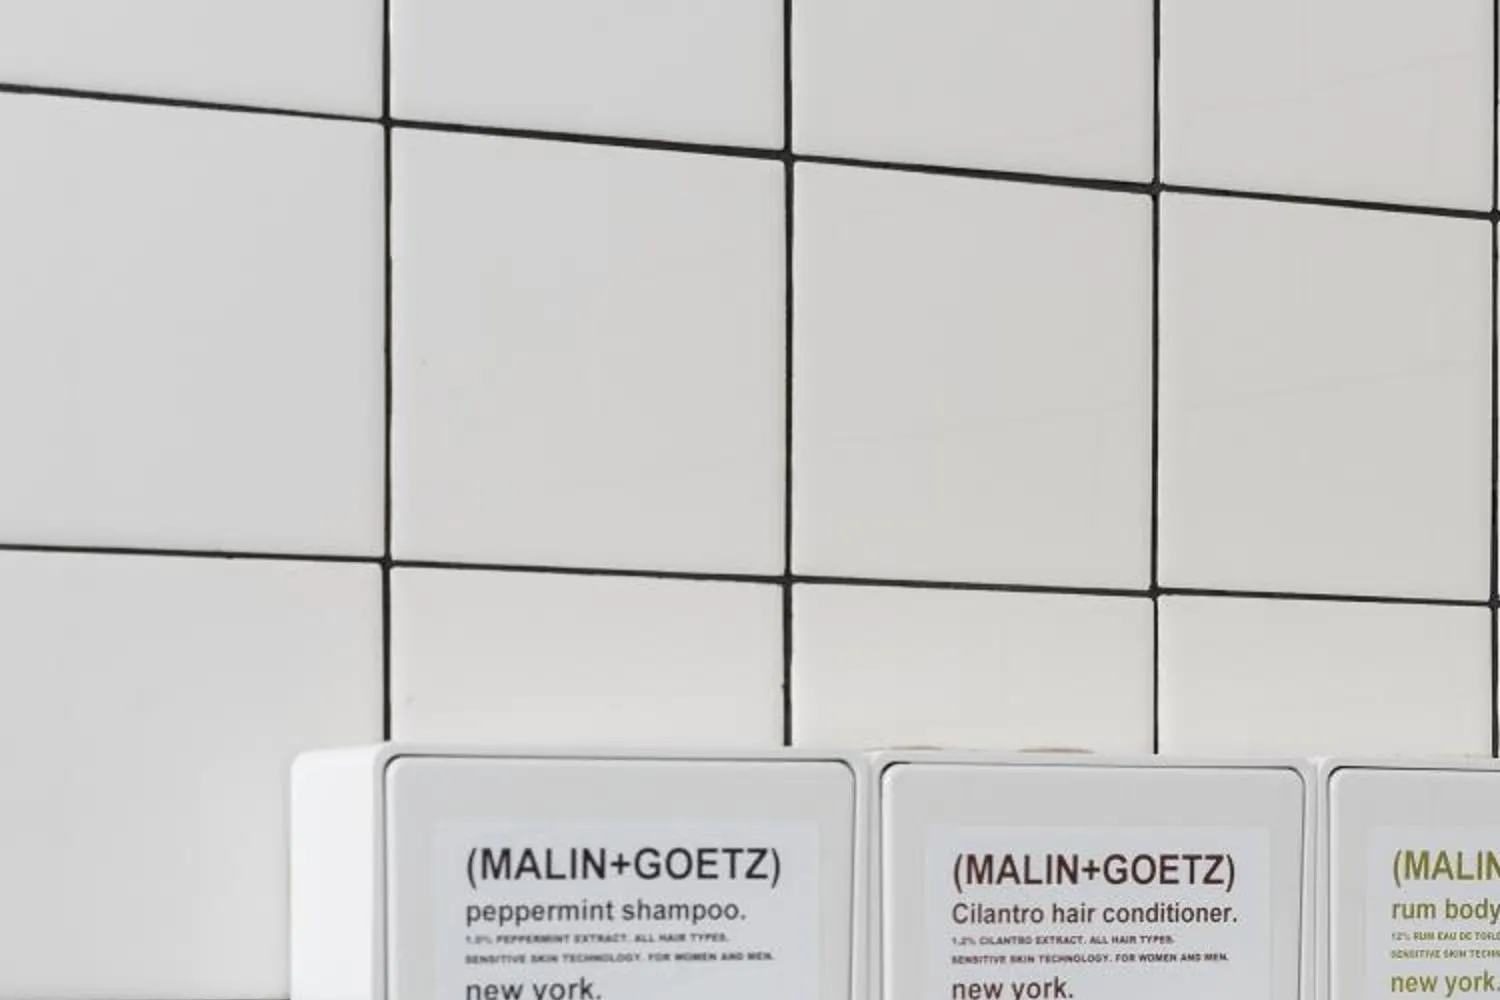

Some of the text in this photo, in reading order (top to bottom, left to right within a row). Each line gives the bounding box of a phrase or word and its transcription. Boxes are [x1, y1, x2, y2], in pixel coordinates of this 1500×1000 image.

[466, 847, 781, 889] (MALIN+GOETZ)
[953, 853, 1235, 893] (MALIN+GOETZ)
[466, 897, 746, 927] peppermint shampoo.
[952, 901, 1238, 925] Cilantro hair conditioner.
[1391, 901, 1437, 920] rum
[496, 934, 570, 945] PEPPERMINT
[634, 932, 655, 943] ALL
[658, 932, 686, 943] HAIR
[978, 935, 1033, 945] CILANTRO
[1089, 934, 1110, 945] ALL
[1111, 934, 1137, 945] HAIR
[1437, 931, 1457, 941] EAU
[465, 953, 526, 965] SENSITIVE
[530, 953, 559, 964] SKIN
[648, 952, 671, 962] FOR
[674, 951, 717, 962] WOMEN
[720, 951, 744, 962] AND
[951, 954, 1007, 965] SENSITIVE
[1009, 954, 1036, 964] SKIN
[1115, 953, 1136, 963] FOR
[1138, 952, 1177, 963] WOMEN
[1180, 952, 1201, 962] AND
[1390, 949, 1441, 959] SENSITIVE
[952, 980, 1003, 1000] new
[1390, 974, 1438, 993] new
